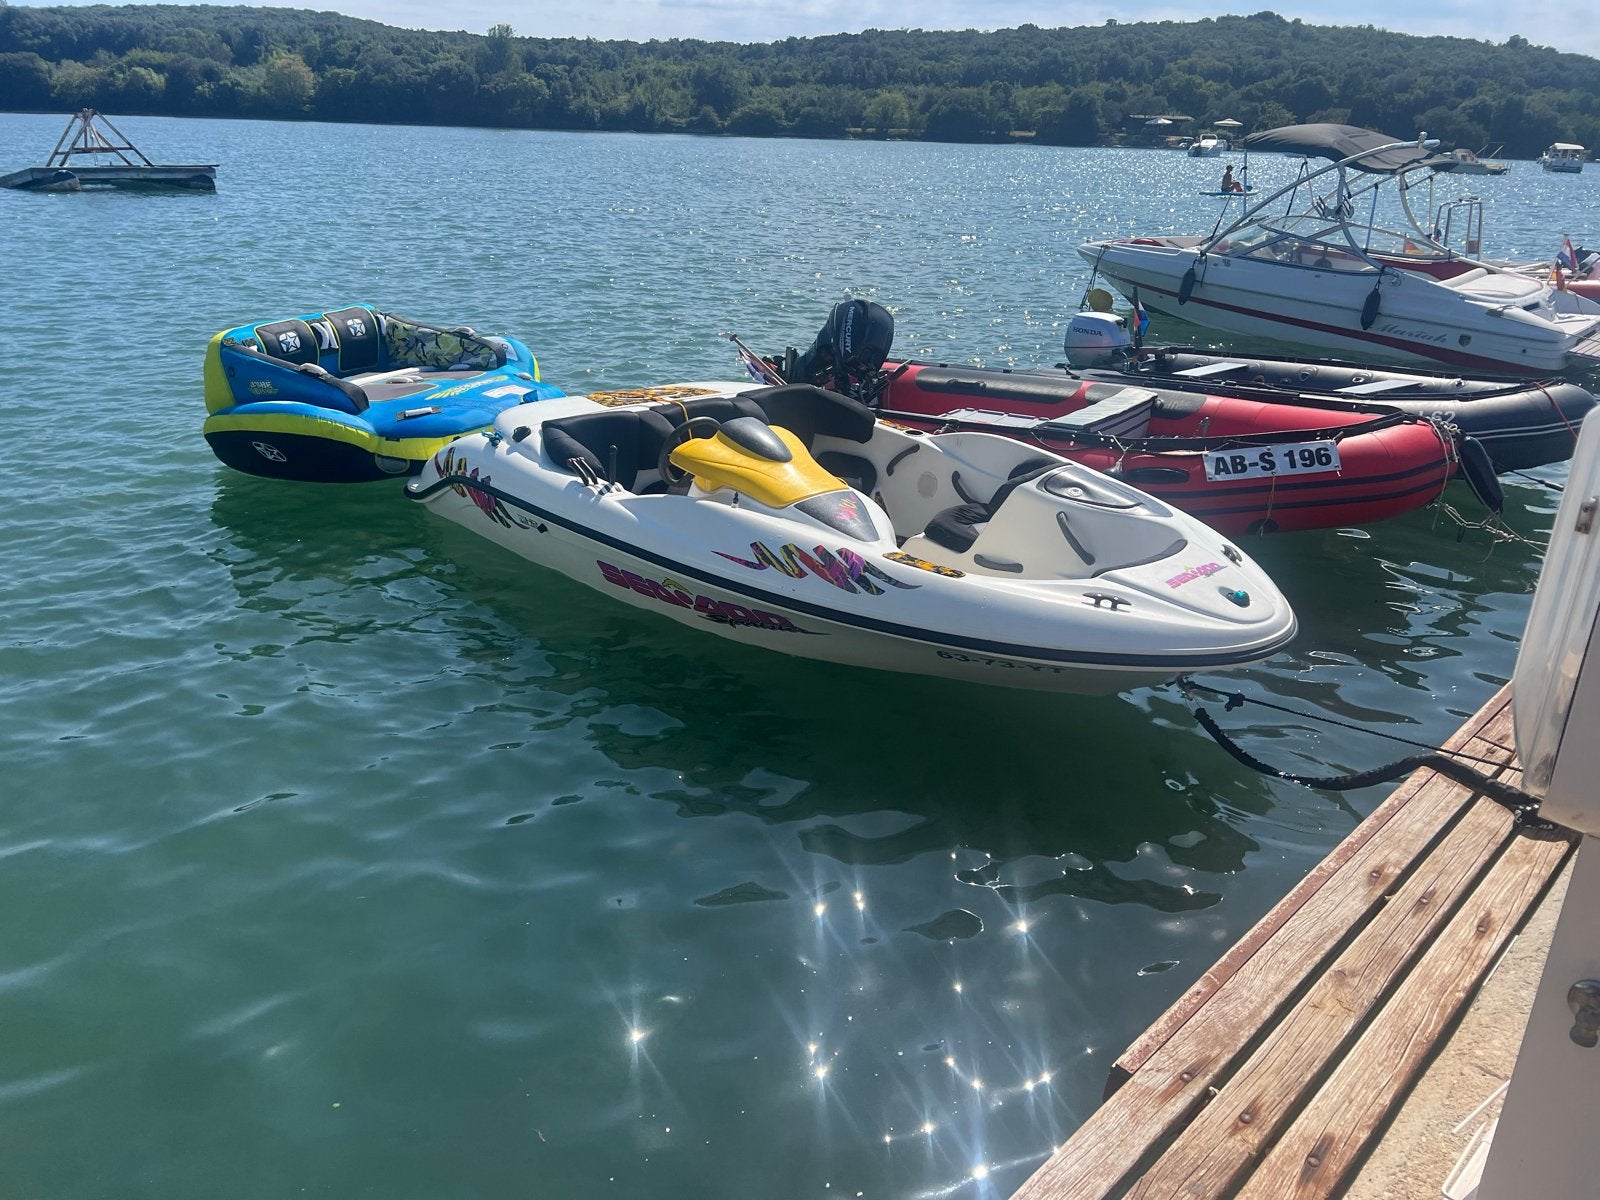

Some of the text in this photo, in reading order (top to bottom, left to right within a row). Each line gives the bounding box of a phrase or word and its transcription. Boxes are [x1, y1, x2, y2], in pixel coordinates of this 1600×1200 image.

[844, 305, 856, 355] MERCURY
[1073, 326, 1103, 337] HONDA
[1214, 447, 1333, 476] AB-S 196
